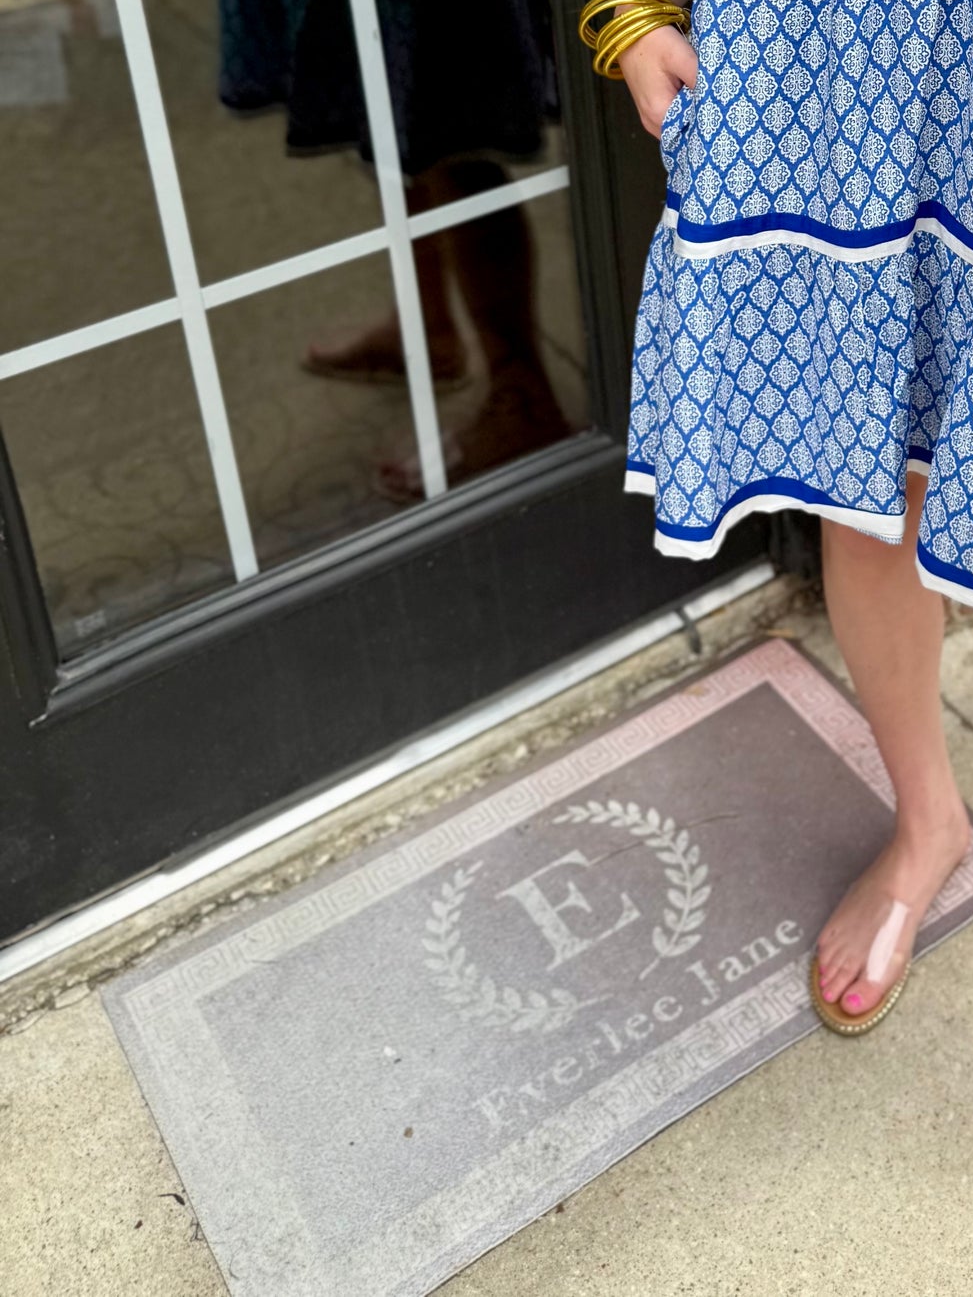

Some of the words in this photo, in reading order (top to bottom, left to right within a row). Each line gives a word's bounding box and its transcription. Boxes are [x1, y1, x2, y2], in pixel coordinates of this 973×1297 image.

[495, 849, 641, 971] E
[474, 995, 684, 1128] Everlee
[685, 918, 804, 1007] Jane
